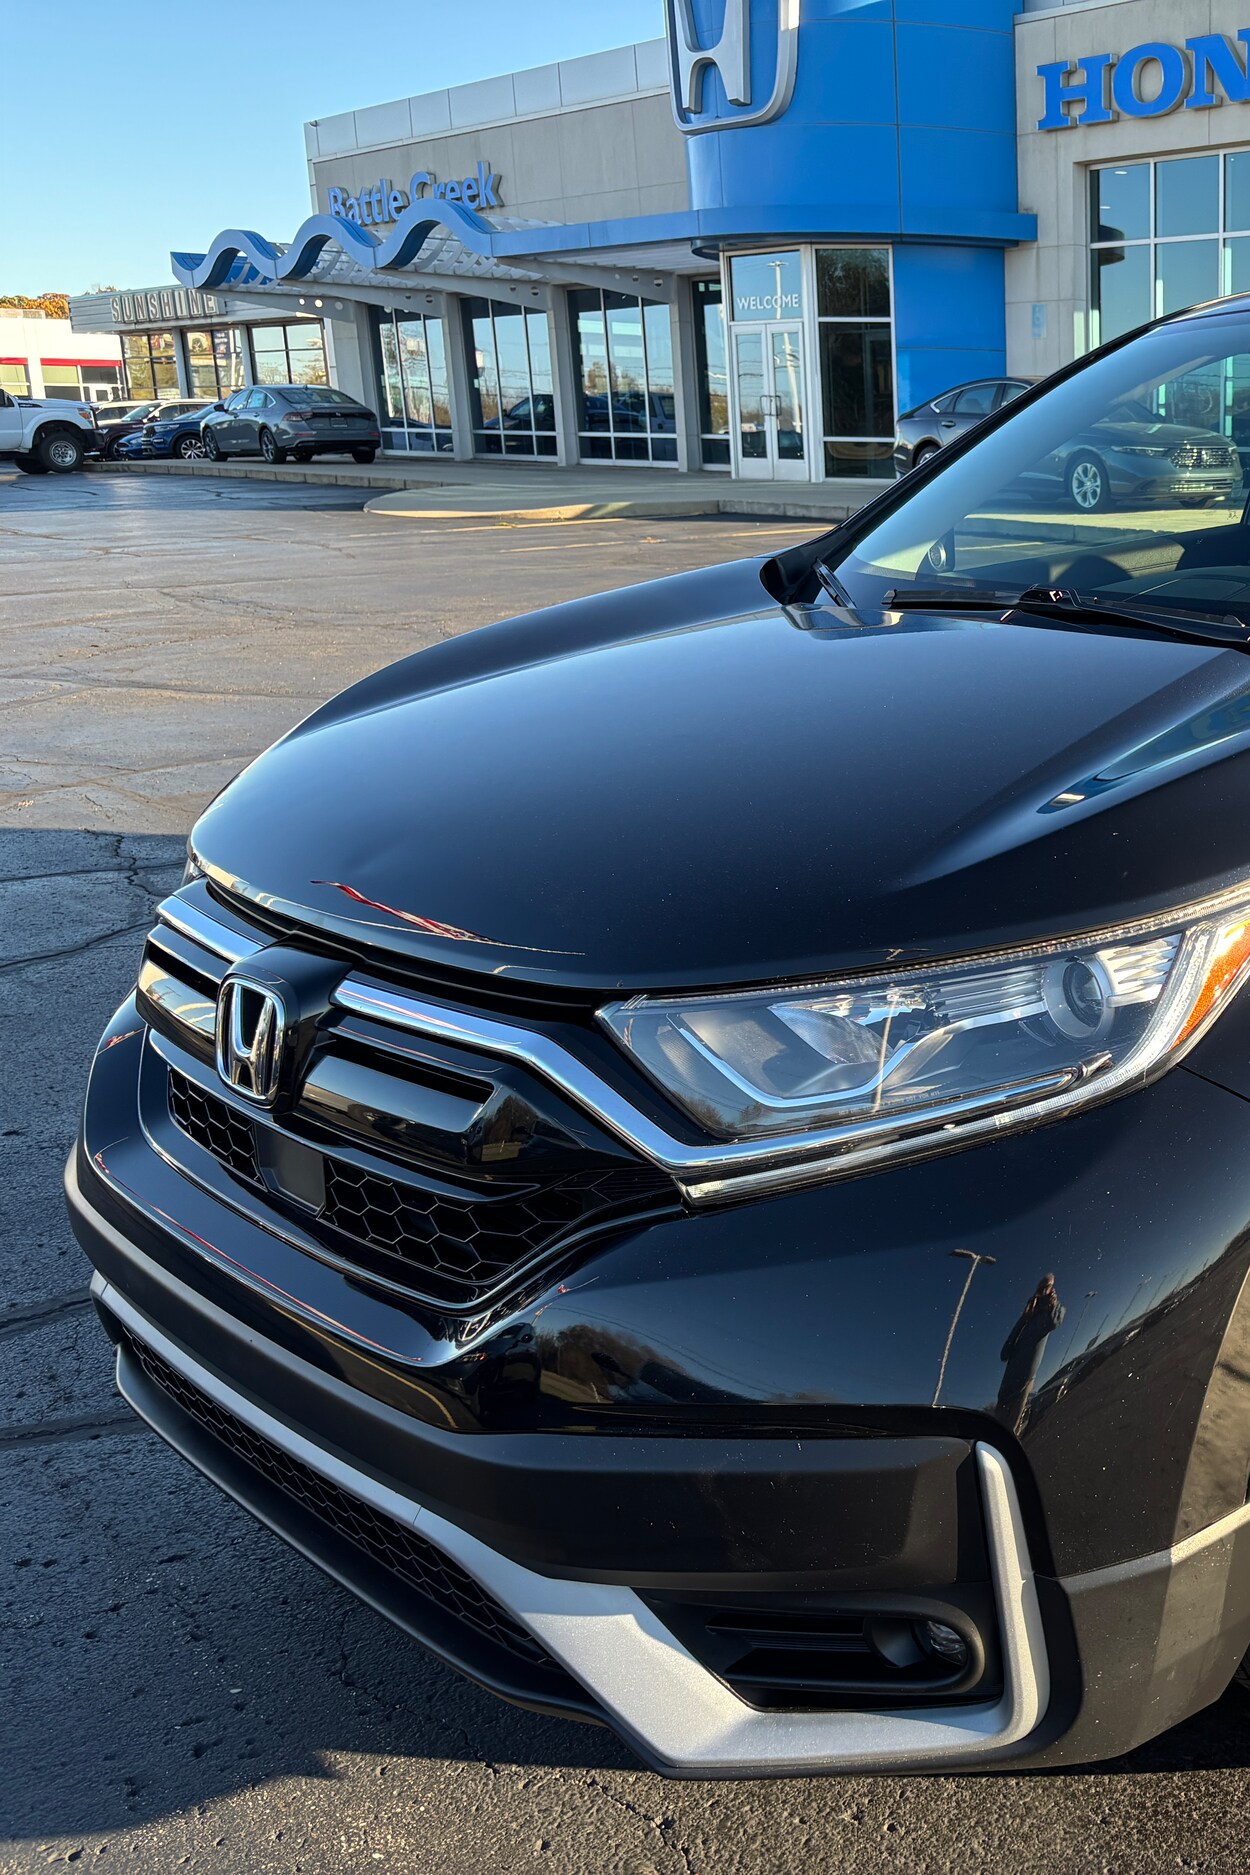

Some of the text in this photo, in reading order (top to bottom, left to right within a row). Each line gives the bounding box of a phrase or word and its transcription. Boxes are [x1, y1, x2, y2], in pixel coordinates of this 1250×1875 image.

[328, 160, 499, 226] Battle Creek
[111, 288, 216, 322] SUNSHINE
[736, 294, 799, 310] WELCOME
